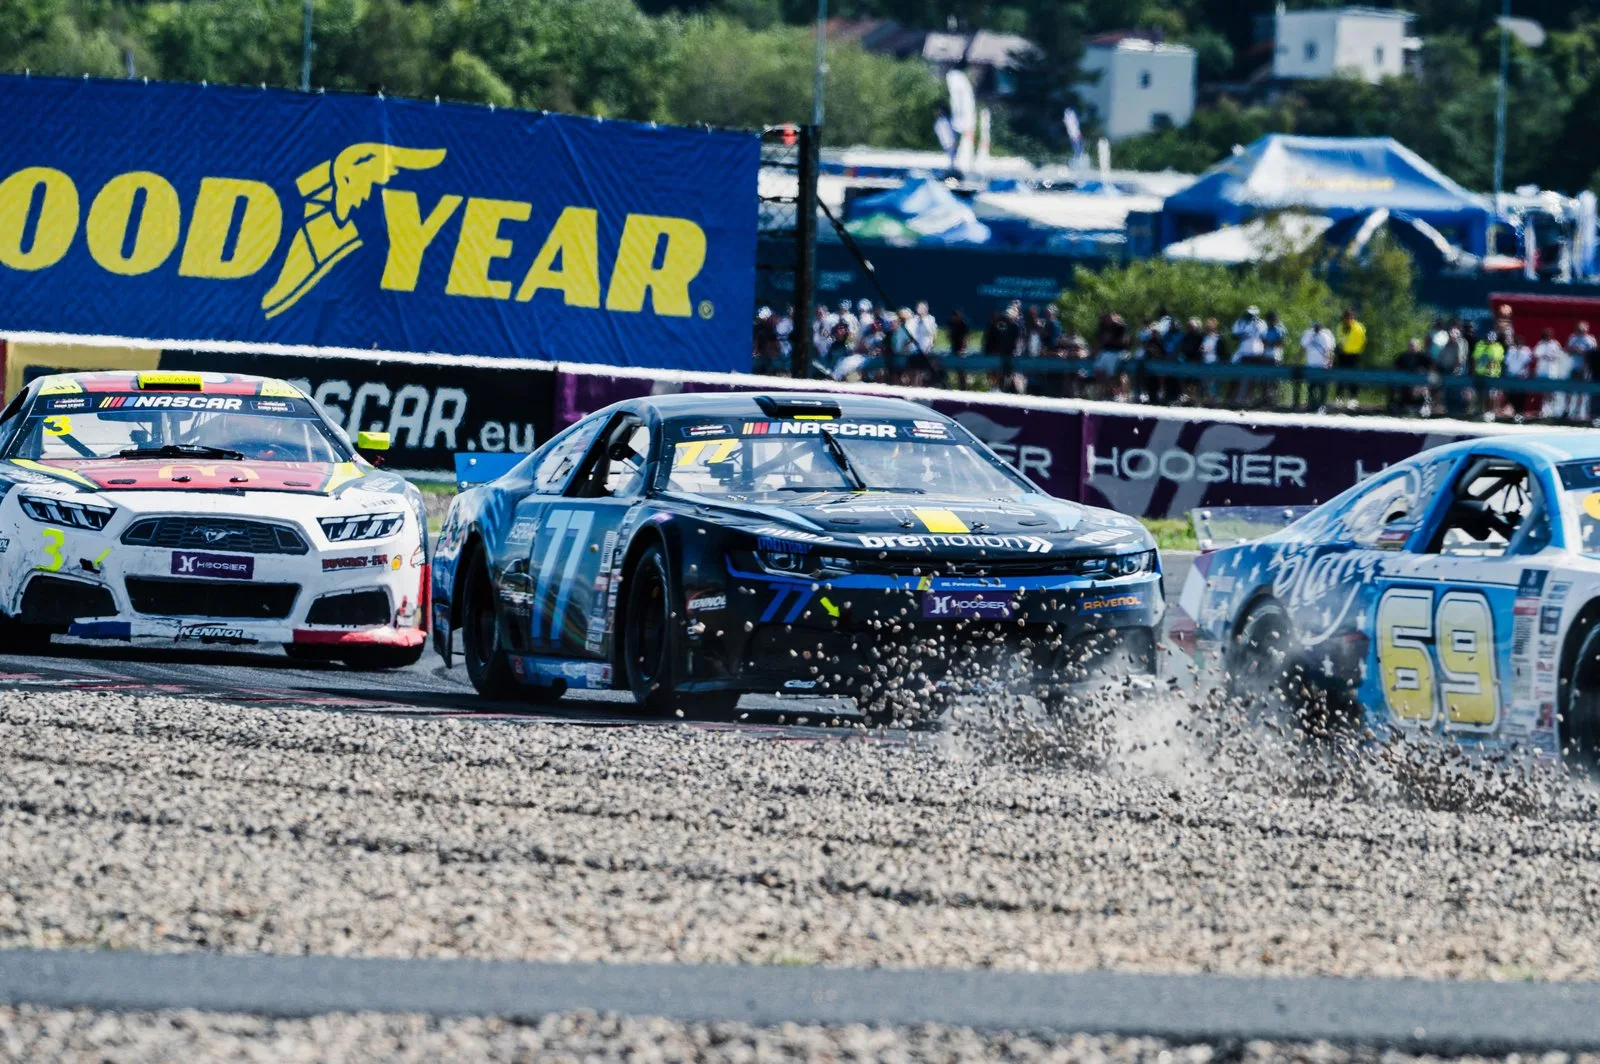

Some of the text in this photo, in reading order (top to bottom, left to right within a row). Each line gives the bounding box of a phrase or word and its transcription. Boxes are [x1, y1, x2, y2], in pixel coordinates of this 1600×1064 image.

[134, 395, 243, 411] NASCAR
[288, 377, 535, 453] SCAR.eu
[43, 414, 73, 437] 3
[780, 422, 897, 438] NASCAR
[675, 438, 740, 466] 77
[1086, 444, 1308, 488] HOOSIER
[36, 527, 66, 572] 3
[857, 534, 1024, 549] bremotion
[196, 560, 248, 572] HOOSIER
[530, 509, 595, 650] 77
[759, 583, 814, 623] 77
[1083, 596, 1142, 610] RAVENOL
[180, 627, 244, 639] KENNOL
[1376, 587, 1502, 734] 69
